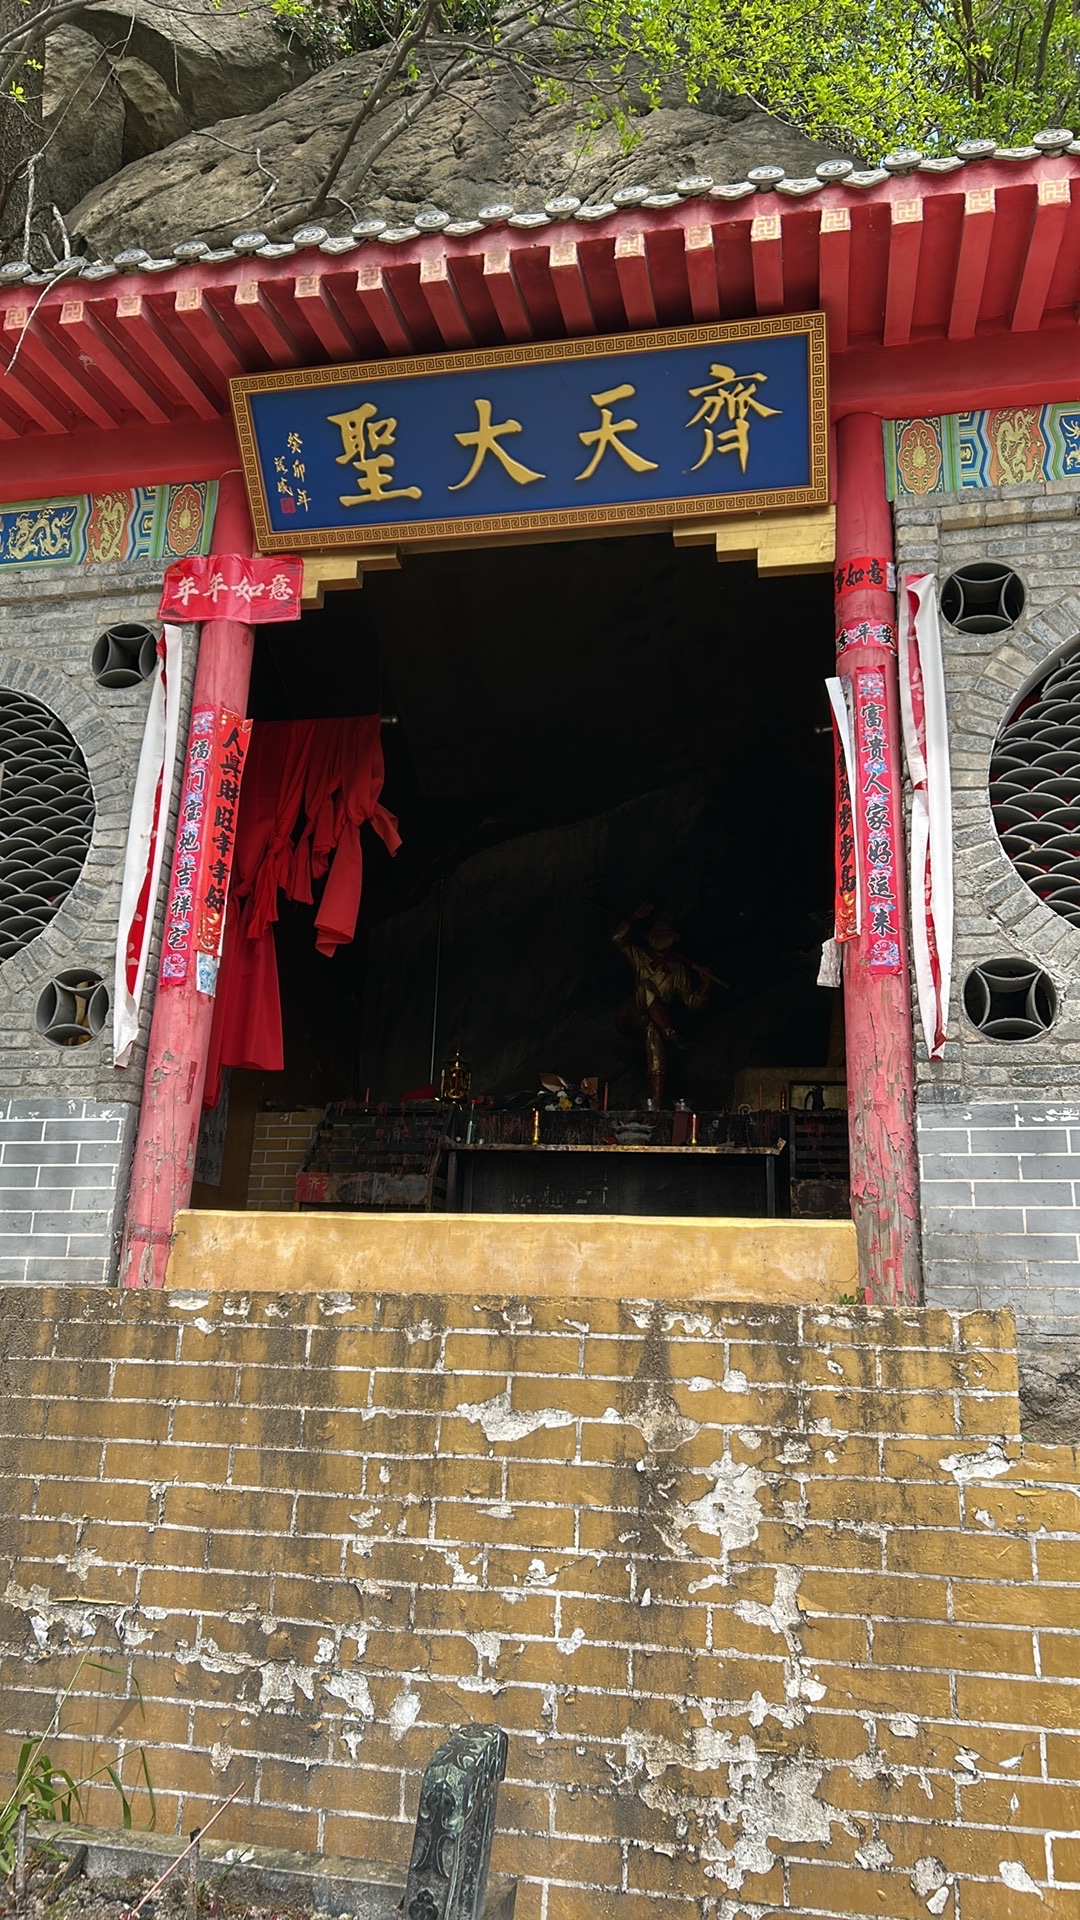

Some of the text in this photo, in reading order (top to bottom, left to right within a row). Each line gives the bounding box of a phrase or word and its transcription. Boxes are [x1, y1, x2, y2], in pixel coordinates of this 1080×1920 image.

[287, 432, 312, 512] 癸卯年
[326, 363, 783, 507] 齊天大聖
[172, 572, 294, 606] 年年如意
[167, 739, 210, 950] 福门宝地吉祥宅
[861, 702, 898, 937] 富贵人家好运来
